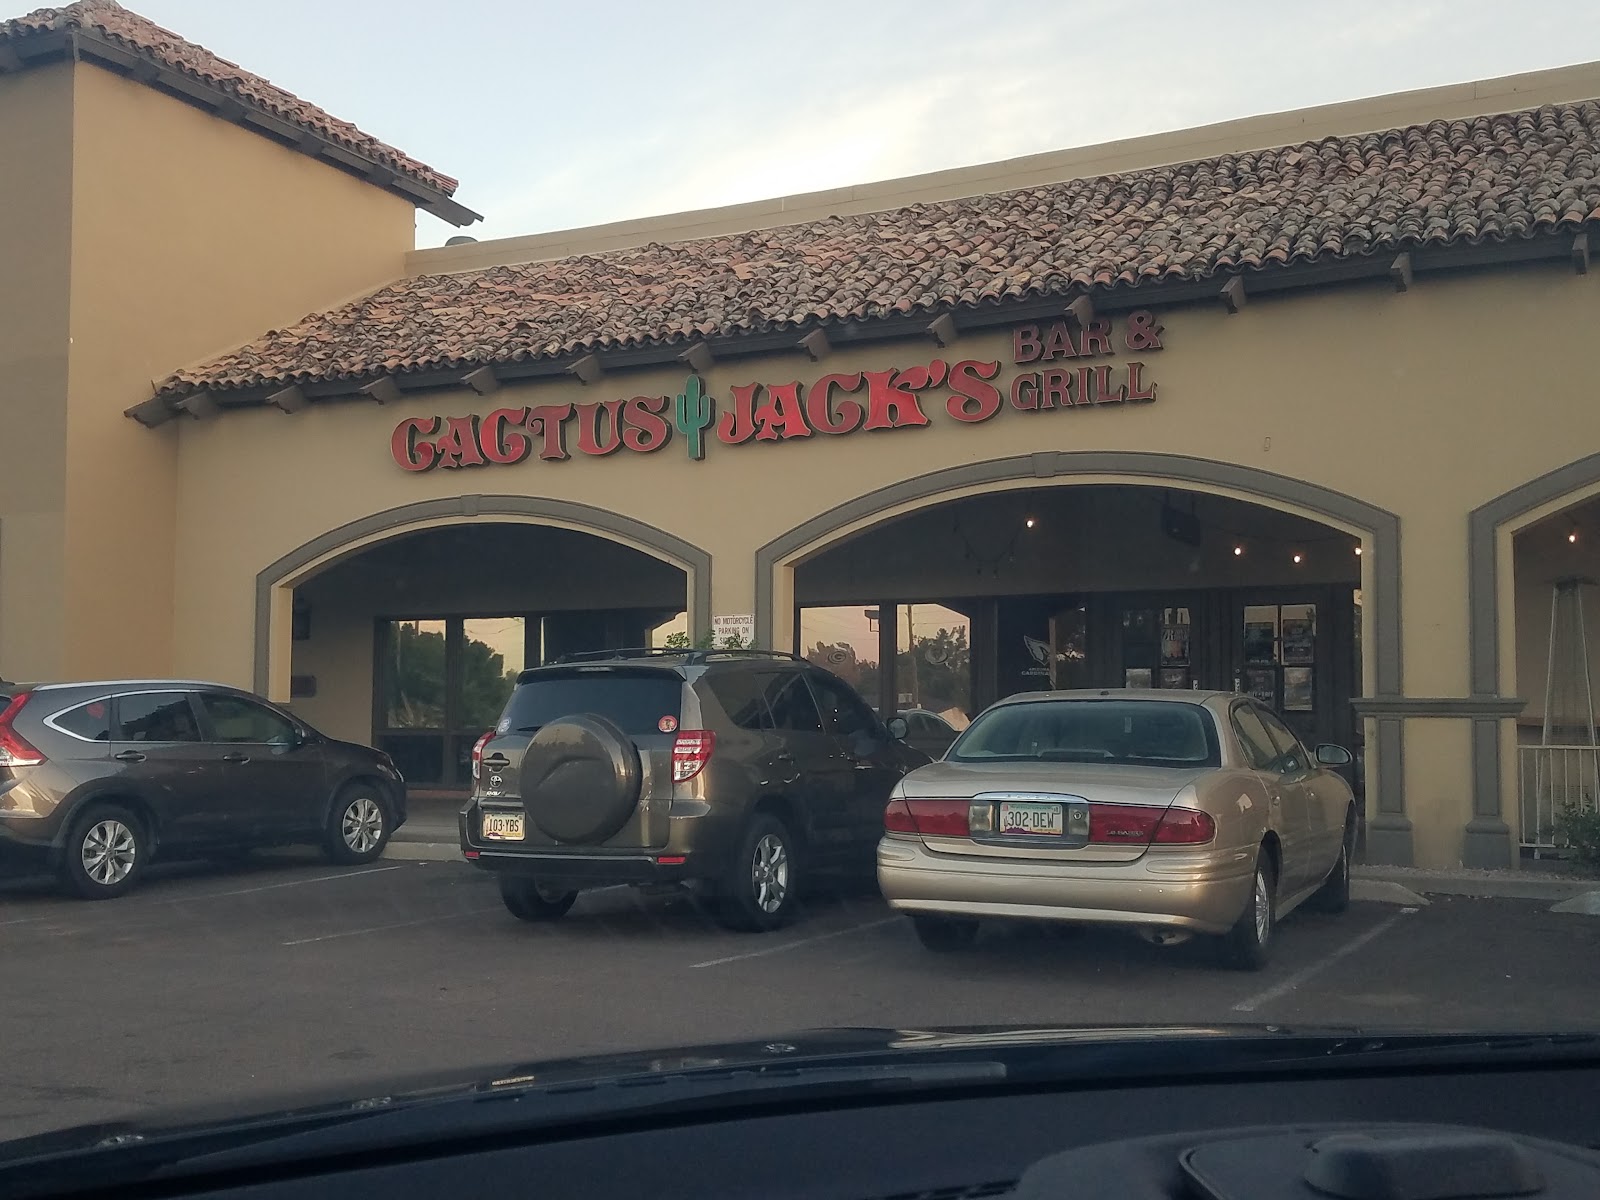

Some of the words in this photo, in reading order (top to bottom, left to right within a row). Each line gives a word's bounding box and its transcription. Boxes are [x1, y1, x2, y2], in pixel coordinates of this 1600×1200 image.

[1013, 319, 1116, 364] BAR
[1125, 310, 1163, 351] &
[1009, 362, 1157, 411] GRILL
[390, 394, 672, 472] CACTUS
[716, 358, 1003, 444] JACK'S
[718, 626, 740, 635] PARKING
[741, 626, 750, 634] ON
[722, 616, 753, 625] MOTORCYCLE
